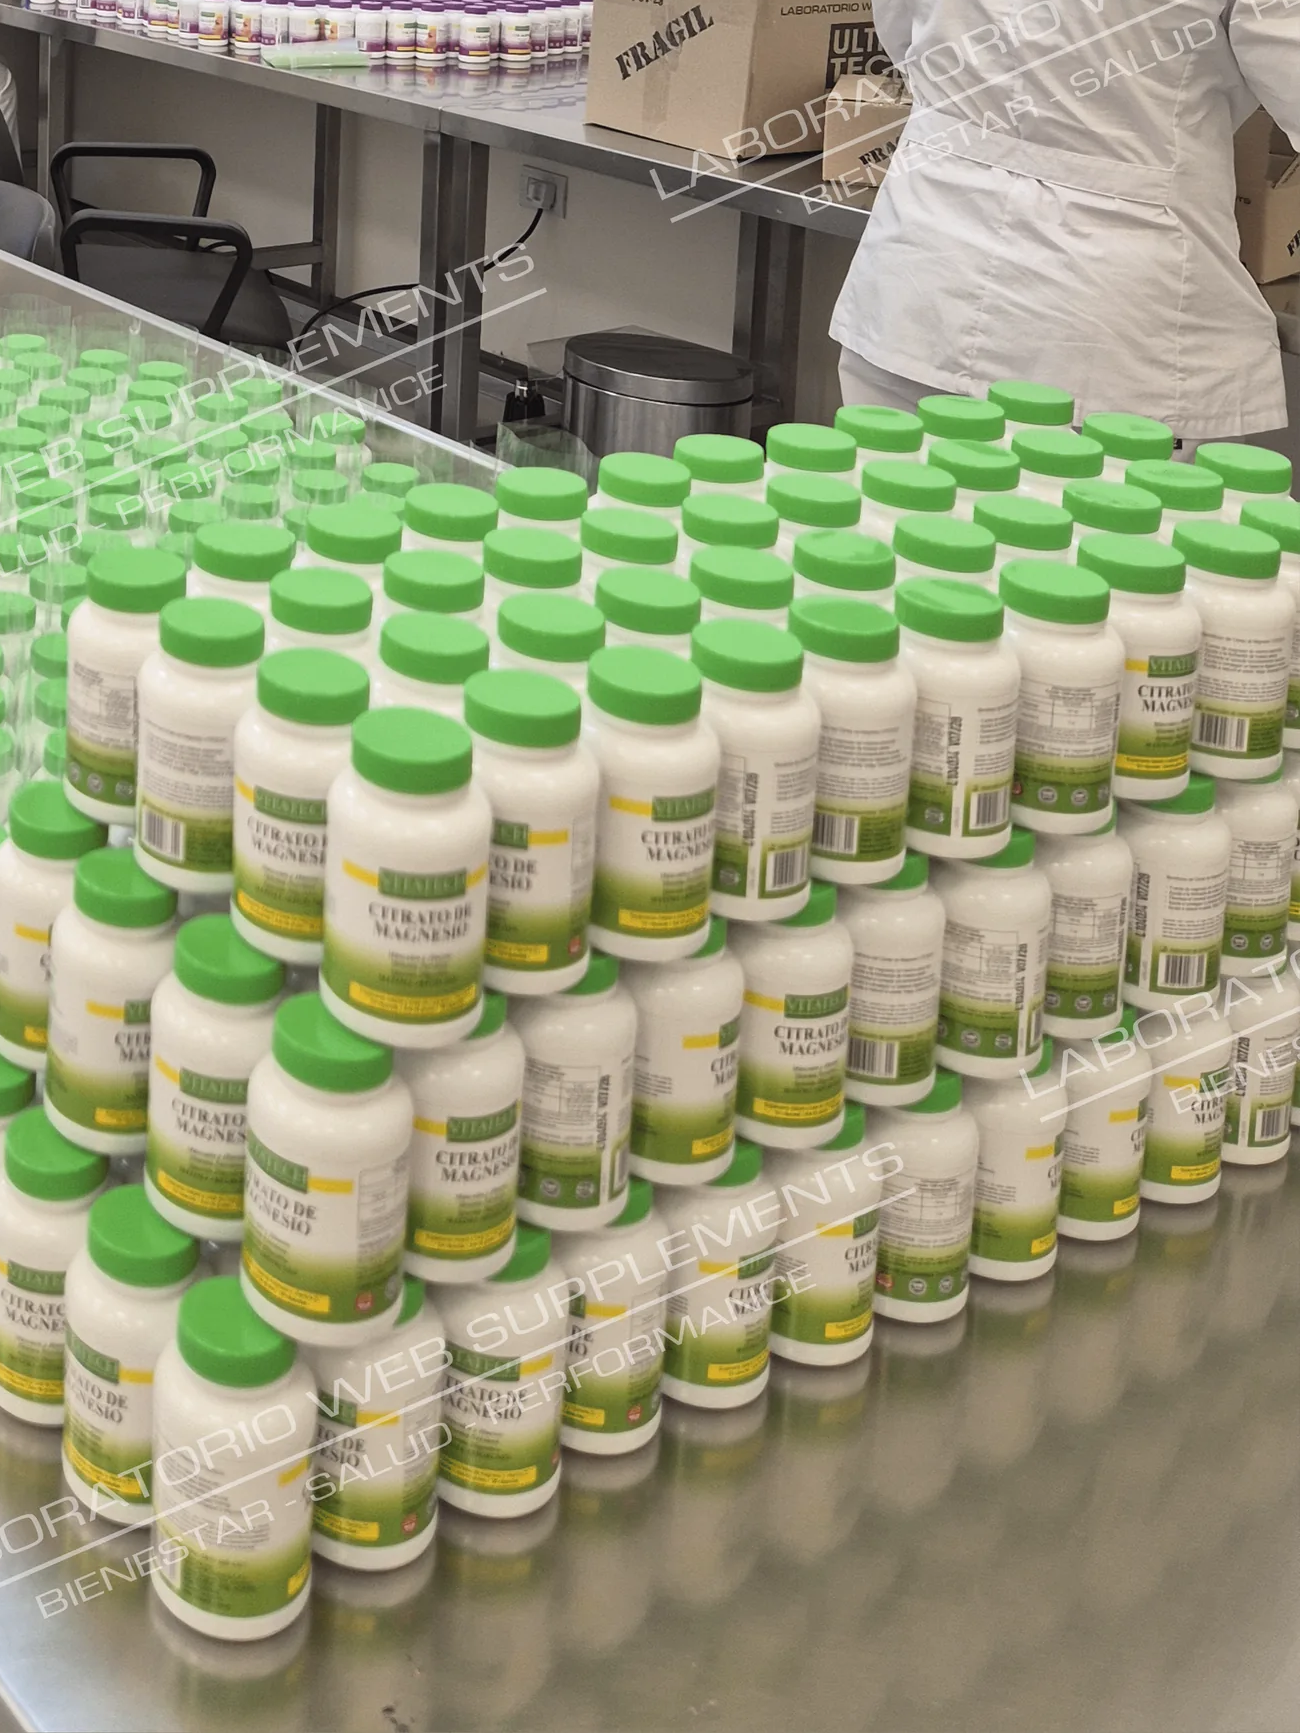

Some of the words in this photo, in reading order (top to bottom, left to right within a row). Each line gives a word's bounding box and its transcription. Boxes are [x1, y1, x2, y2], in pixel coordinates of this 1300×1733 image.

[780, 3, 859, 16] LABORATORIO
[614, 5, 715, 81] FRAGIL
[369, 902, 450, 925] CITRATO
[373, 920, 468, 944] MAGNESIO
[171, 1097, 246, 1127] CITRATO
[293, 1202, 317, 1220] DE
[105, 1392, 128, 1409] DE
[342, 1436, 366, 1453] DE
